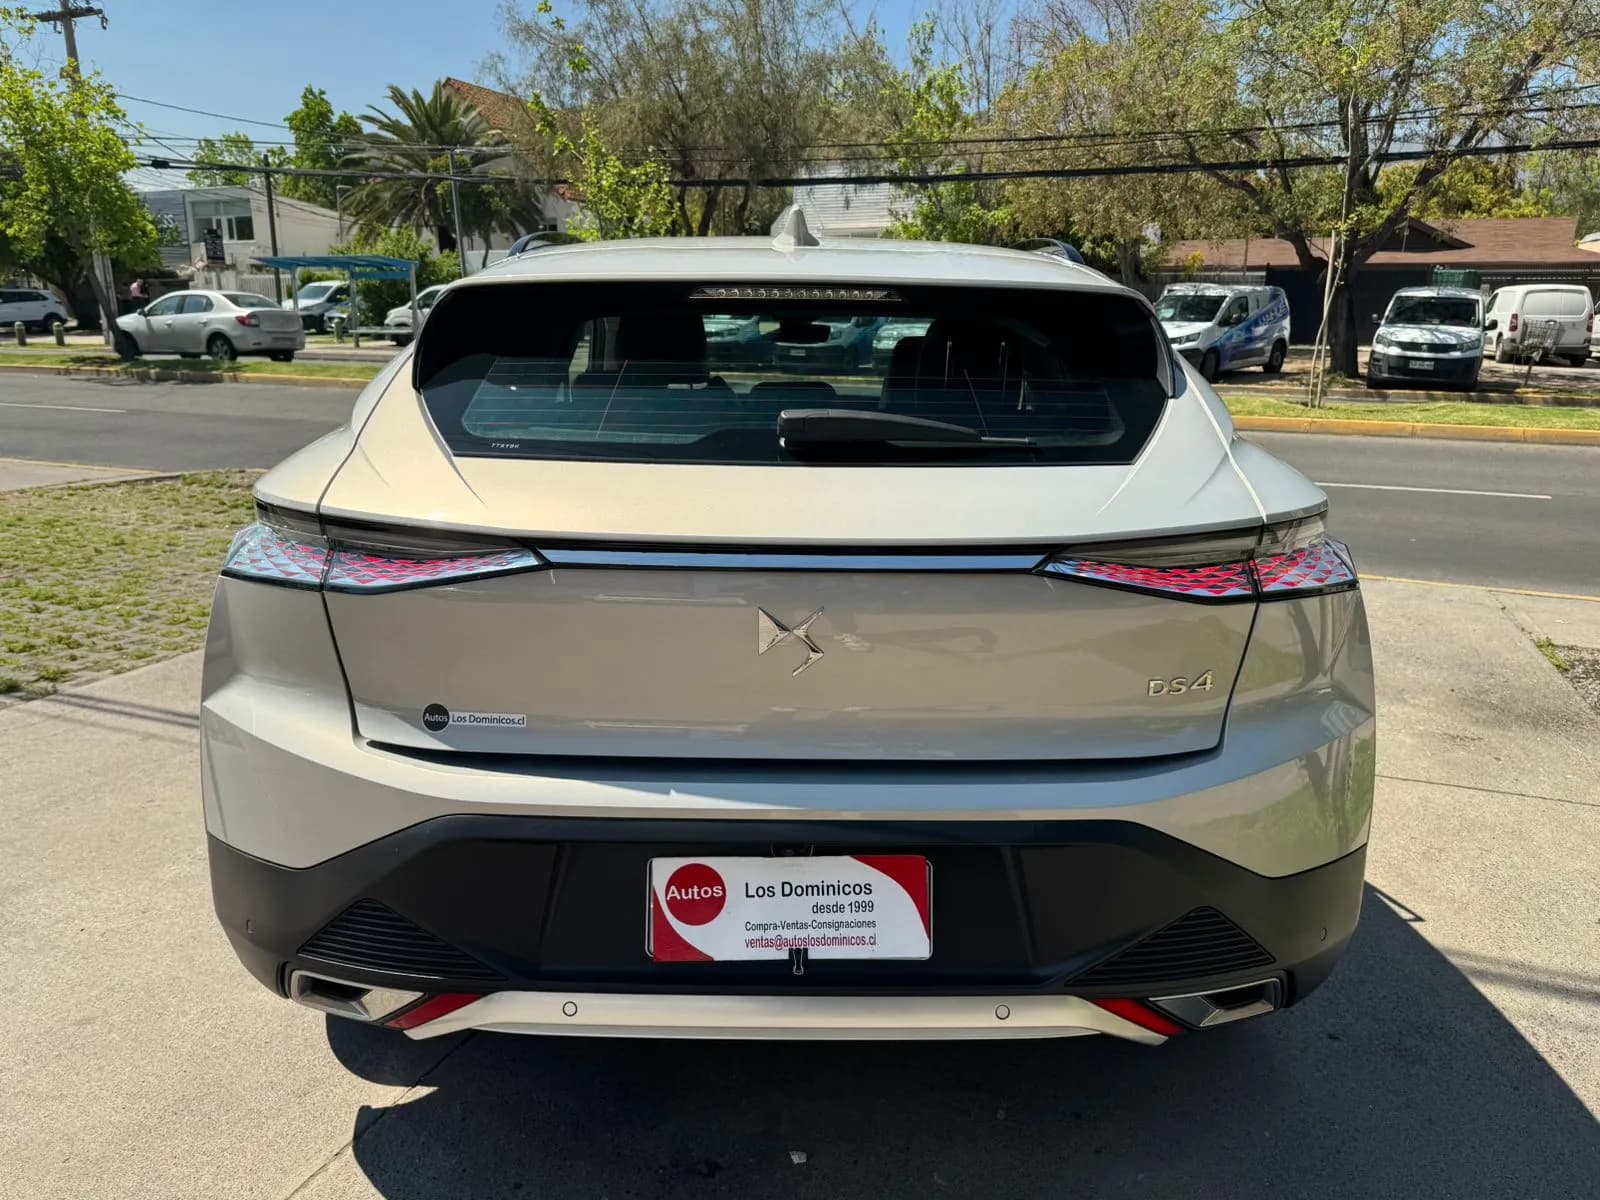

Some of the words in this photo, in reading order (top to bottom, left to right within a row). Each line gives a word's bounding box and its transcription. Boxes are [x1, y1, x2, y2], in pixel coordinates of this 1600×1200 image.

[1147, 669, 1214, 697] DS4
[424, 713, 449, 722] Autos
[452, 714, 467, 723] Los
[469, 714, 525, 726] Dominicos.cl
[666, 884, 723, 901] Autos
[745, 882, 776, 898] Los
[781, 880, 873, 897] Dominicos
[812, 901, 846, 914] desde
[848, 900, 875, 914] 1999
[745, 919, 877, 933] Compra-Ventas-Consignaciones
[744, 933, 878, 951] ventas@autoslosdominicos.cl
